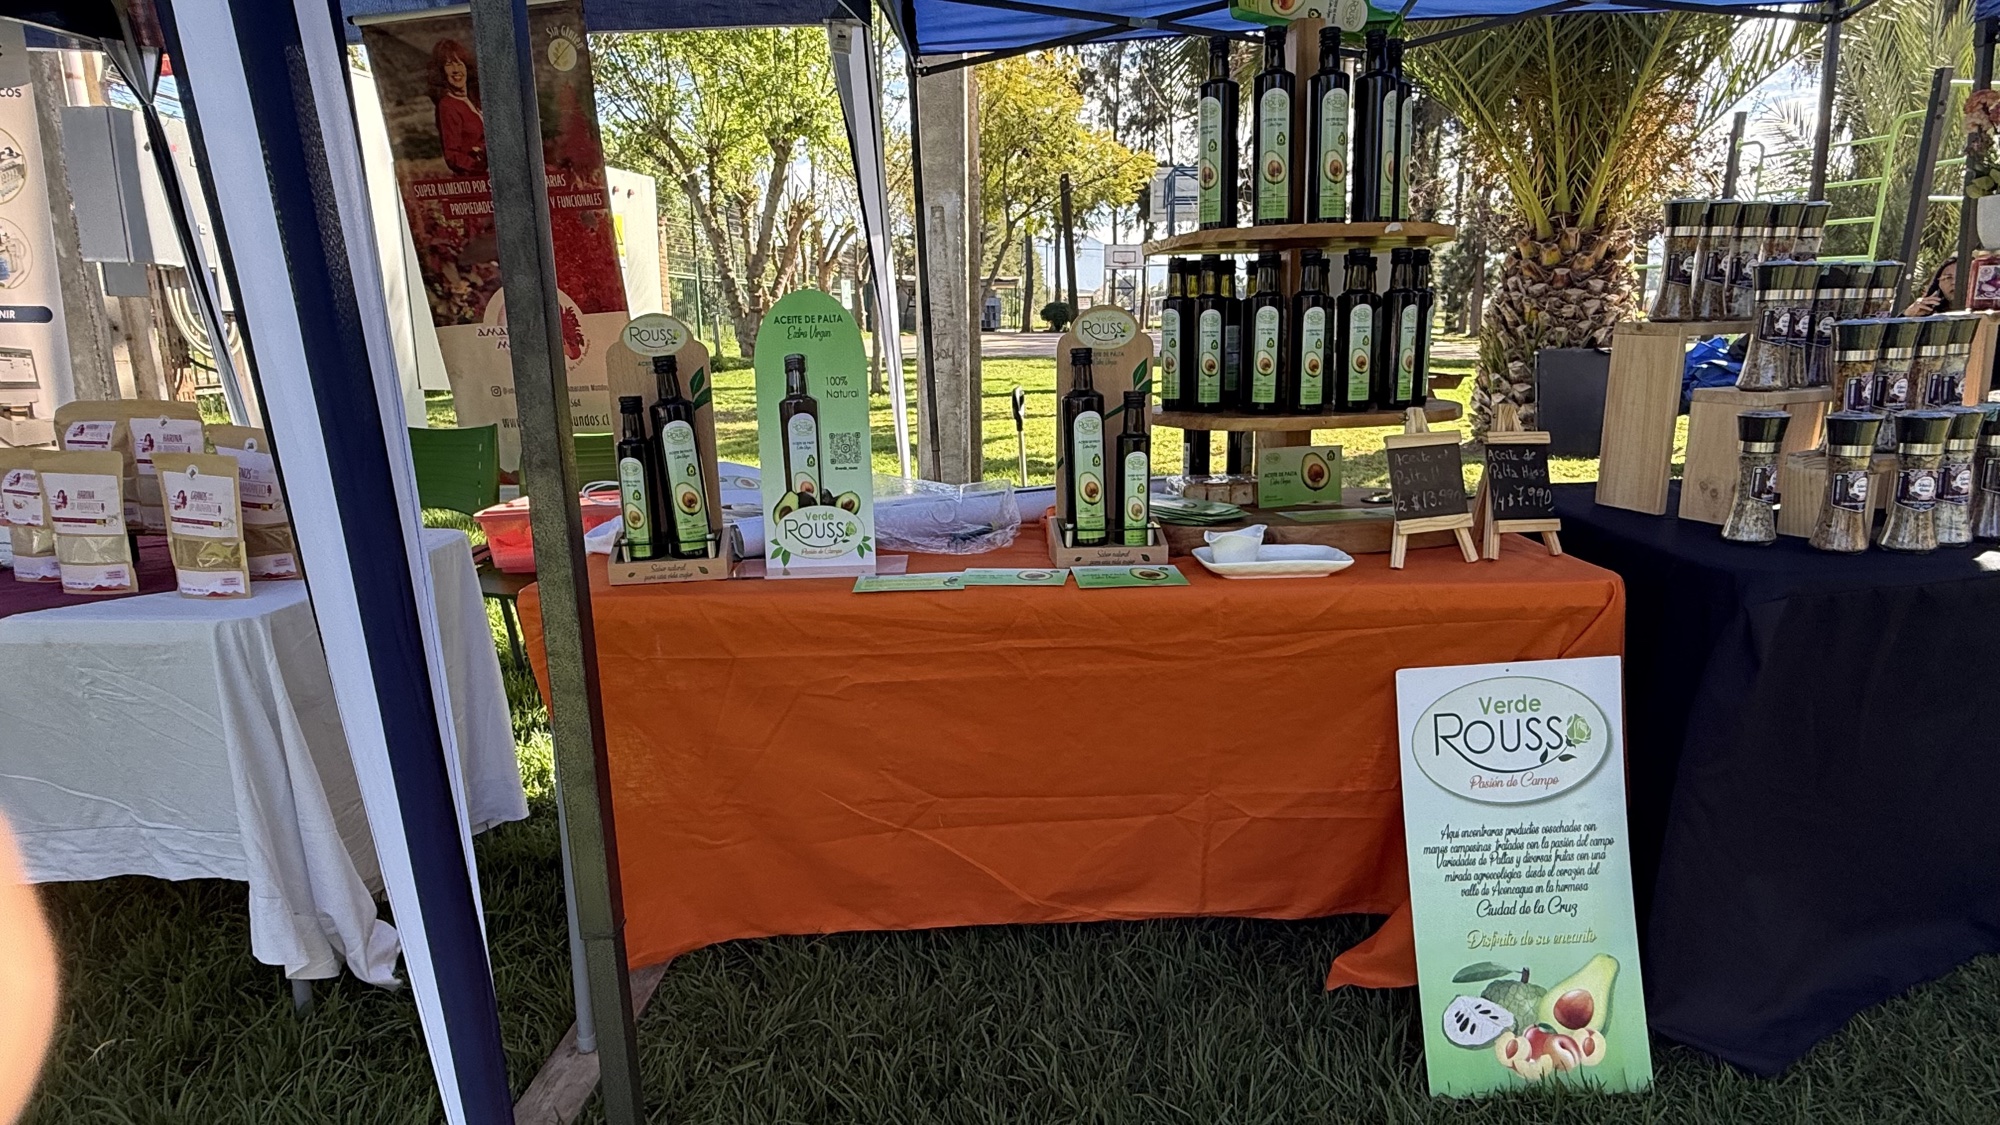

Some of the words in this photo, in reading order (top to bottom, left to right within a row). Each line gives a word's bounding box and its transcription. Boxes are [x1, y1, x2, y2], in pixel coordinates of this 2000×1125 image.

[545, 26, 559, 38] Sin
[560, 25, 585, 49] Gluten
[413, 184, 437, 198] SUPER
[437, 181, 471, 196] ALIMENTO
[472, 179, 487, 194] POR
[450, 200, 494, 216] PROPIEDADES
[551, 196, 556, 208] Y
[556, 193, 602, 209] FUNCIONALES
[774, 315, 802, 325] ACEITE
[805, 315, 816, 324] DE
[817, 314, 843, 323] PALTA
[787, 325, 808, 340] Extra
[809, 325, 832, 342] Virgen
[826, 376, 848, 386] 100%
[826, 388, 859, 399] Natural
[1487, 449, 1519, 461] Aceite
[1522, 448, 1536, 461] de
[1489, 462, 1519, 479] Palta
[805, 511, 835, 521] Verde
[1478, 694, 1542, 715] Verde
[1470, 774, 1504, 791] Pasión
[1504, 775, 1518, 788] de
[1519, 771, 1560, 791] Campo
[1461, 823, 1503, 838] encontraras
[1504, 821, 1540, 841] productos
[1541, 819, 1582, 834] cosechados
[1583, 823, 1597, 832] con
[1423, 845, 1448, 855] manos
[1450, 841, 1491, 857] campesinas
[1495, 837, 1524, 851] tratados
[1526, 840, 1539, 849] con
[1541, 835, 1549, 849] la
[1550, 837, 1575, 853] pasión
[1576, 833, 1589, 847] del
[1589, 837, 1615, 851] campo
[1436, 852, 1476, 869] Variedades
[1478, 852, 1487, 865] de
[1489, 850, 1514, 866] Paltas
[1515, 855, 1521, 868] y
[1523, 850, 1552, 863] diversas
[1552, 849, 1575, 867] frutas
[1576, 852, 1589, 861] con
[1591, 851, 1606, 860] una
[1444, 868, 1472, 882] mirada
[1473, 866, 1522, 885] agroecológica
[1525, 864, 1546, 878] desde
[1547, 863, 1556, 877] el
[1555, 866, 1586, 881] corazón
[1587, 862, 1601, 875] del
[1461, 882, 1480, 897] valle
[1480, 881, 1490, 896] de
[1491, 880, 1534, 898] Aconcagua
[1535, 885, 1544, 894] en
[1545, 879, 1554, 893] la
[1555, 879, 1589, 892] hermosa
[1476, 898, 1518, 918] Ciudad
[1519, 900, 1532, 915] de
[1533, 898, 1545, 914] la
[1547, 895, 1578, 918] Cruz
[1520, 929, 1533, 946] de
[1535, 934, 1551, 946] su
[1553, 926, 1597, 945] encanto
